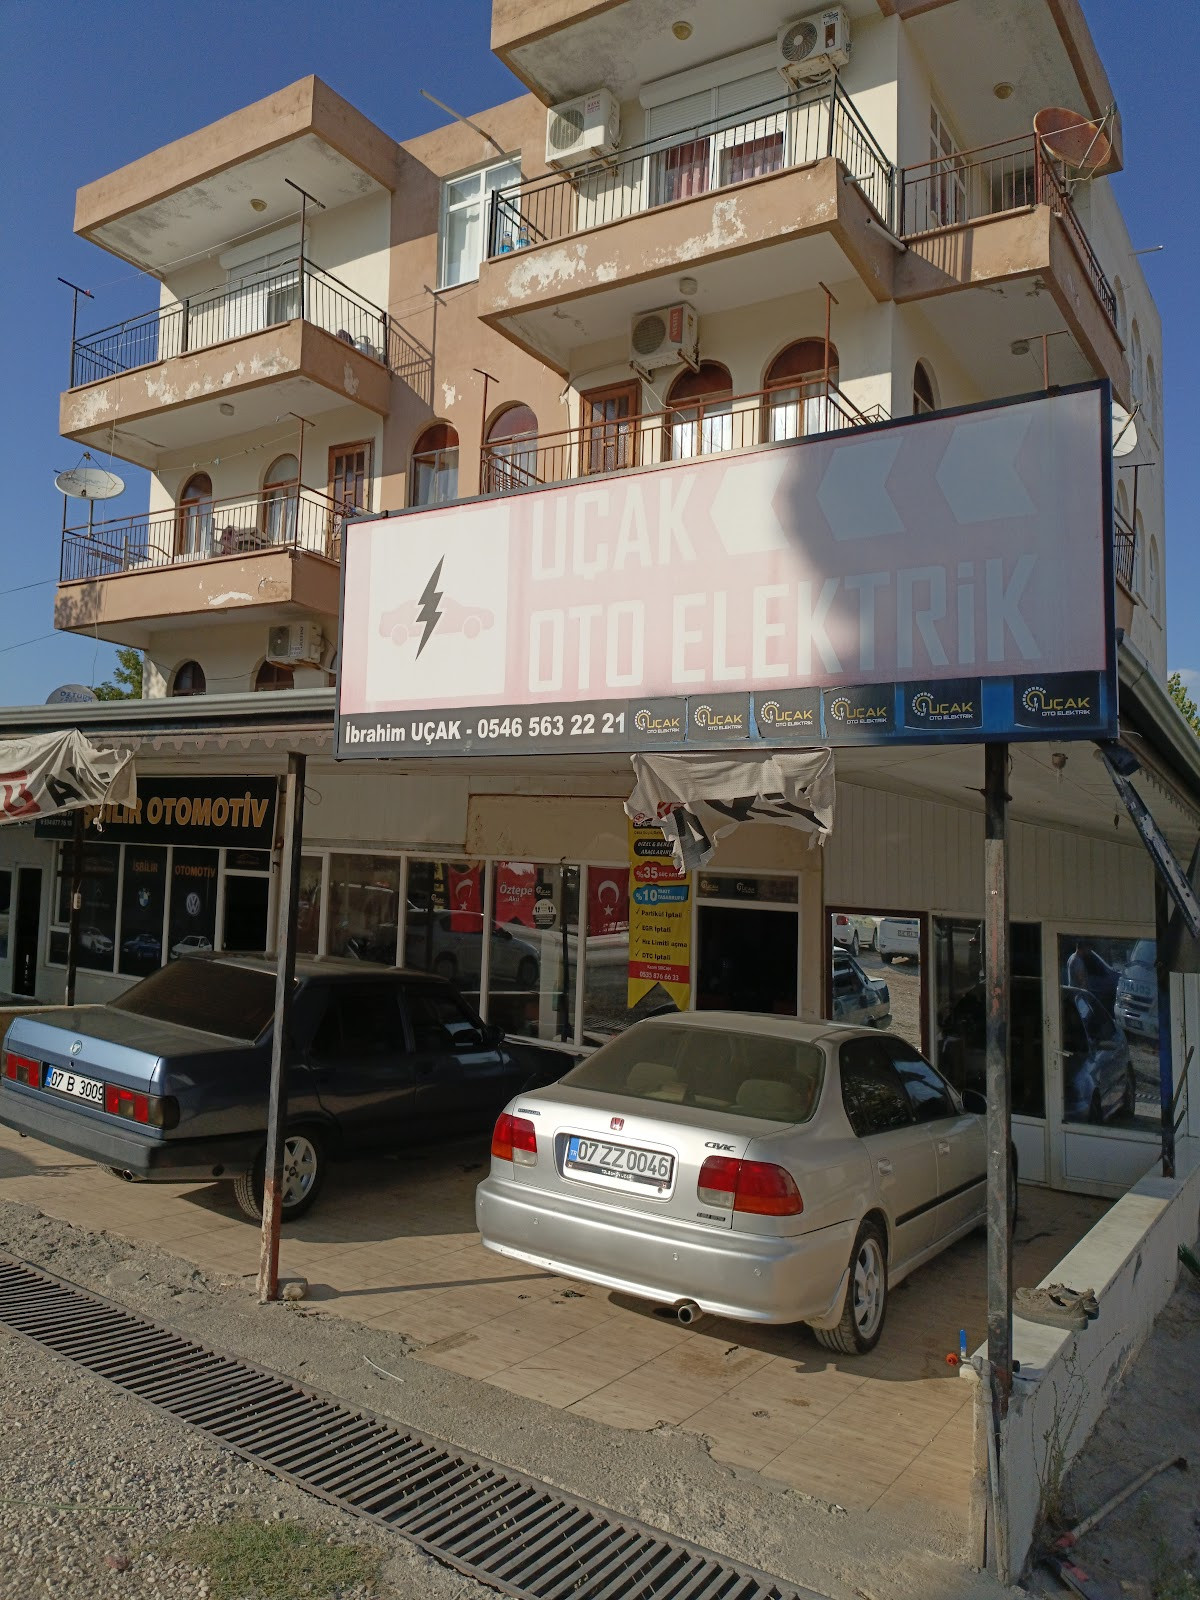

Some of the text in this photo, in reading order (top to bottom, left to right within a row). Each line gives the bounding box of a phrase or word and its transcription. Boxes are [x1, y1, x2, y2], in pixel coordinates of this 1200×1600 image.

[531, 473, 697, 581] UÇAK
[528, 553, 1044, 693] OTO ELEKTRİK
[928, 701, 973, 714] UÇAK
[1041, 697, 1090, 710] UÇAK
[707, 714, 742, 725] UÇAK
[775, 709, 813, 721] UÇAK
[849, 707, 887, 719] UÇAK
[345, 721, 406, 744] İbrahim
[411, 720, 462, 745] UÇAK
[477, 717, 523, 738] 0546
[528, 714, 565, 736] 563
[570, 713, 595, 735] 22
[601, 712, 626, 734] 21
[646, 717, 680, 728] UÇAK
[146, 791, 270, 828] OTOMOTİV
[499, 881, 533, 897] Öztepe
[51, 1071, 103, 1101] 07 B 3009
[577, 1140, 600, 1162] 07
[599, 1145, 626, 1169] ZZ
[626, 1150, 670, 1177] 0046
